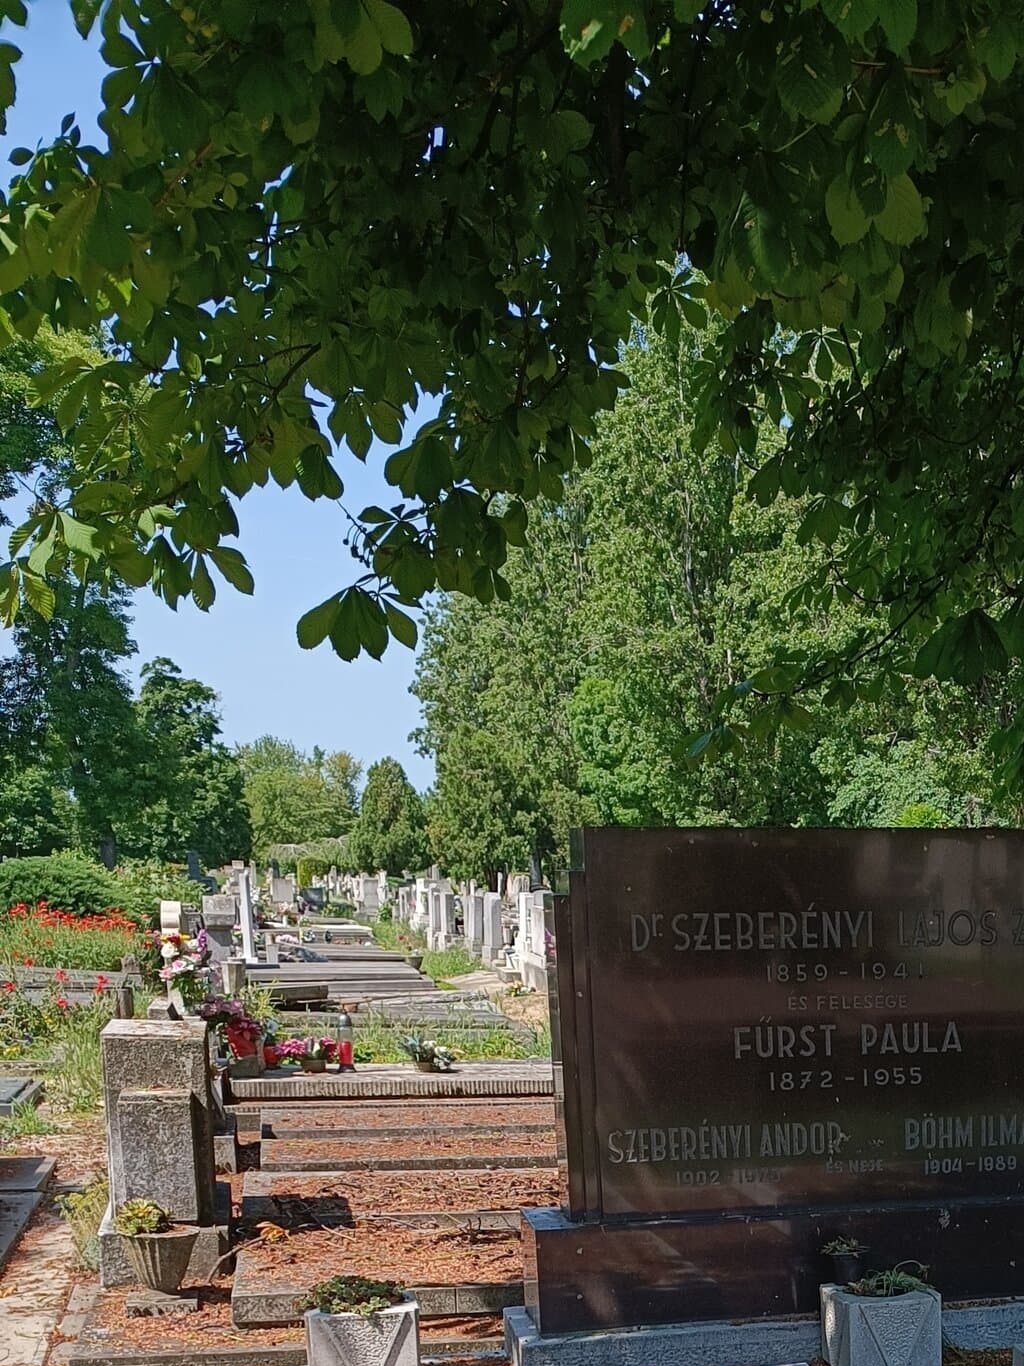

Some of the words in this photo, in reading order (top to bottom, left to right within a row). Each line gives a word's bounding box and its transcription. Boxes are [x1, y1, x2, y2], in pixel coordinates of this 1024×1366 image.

[630, 912, 664, 952] Dr.
[670, 902, 873, 951] SZEBERÉNYI
[897, 909, 1000, 948] LAJOS
[733, 1016, 836, 1059] FŰRST
[861, 1021, 963, 1056] PAULA
[607, 1118, 751, 1164] SZEBERÉNYI
[759, 1120, 842, 1158] ANDOR
[904, 1112, 973, 1151] BÖHM
